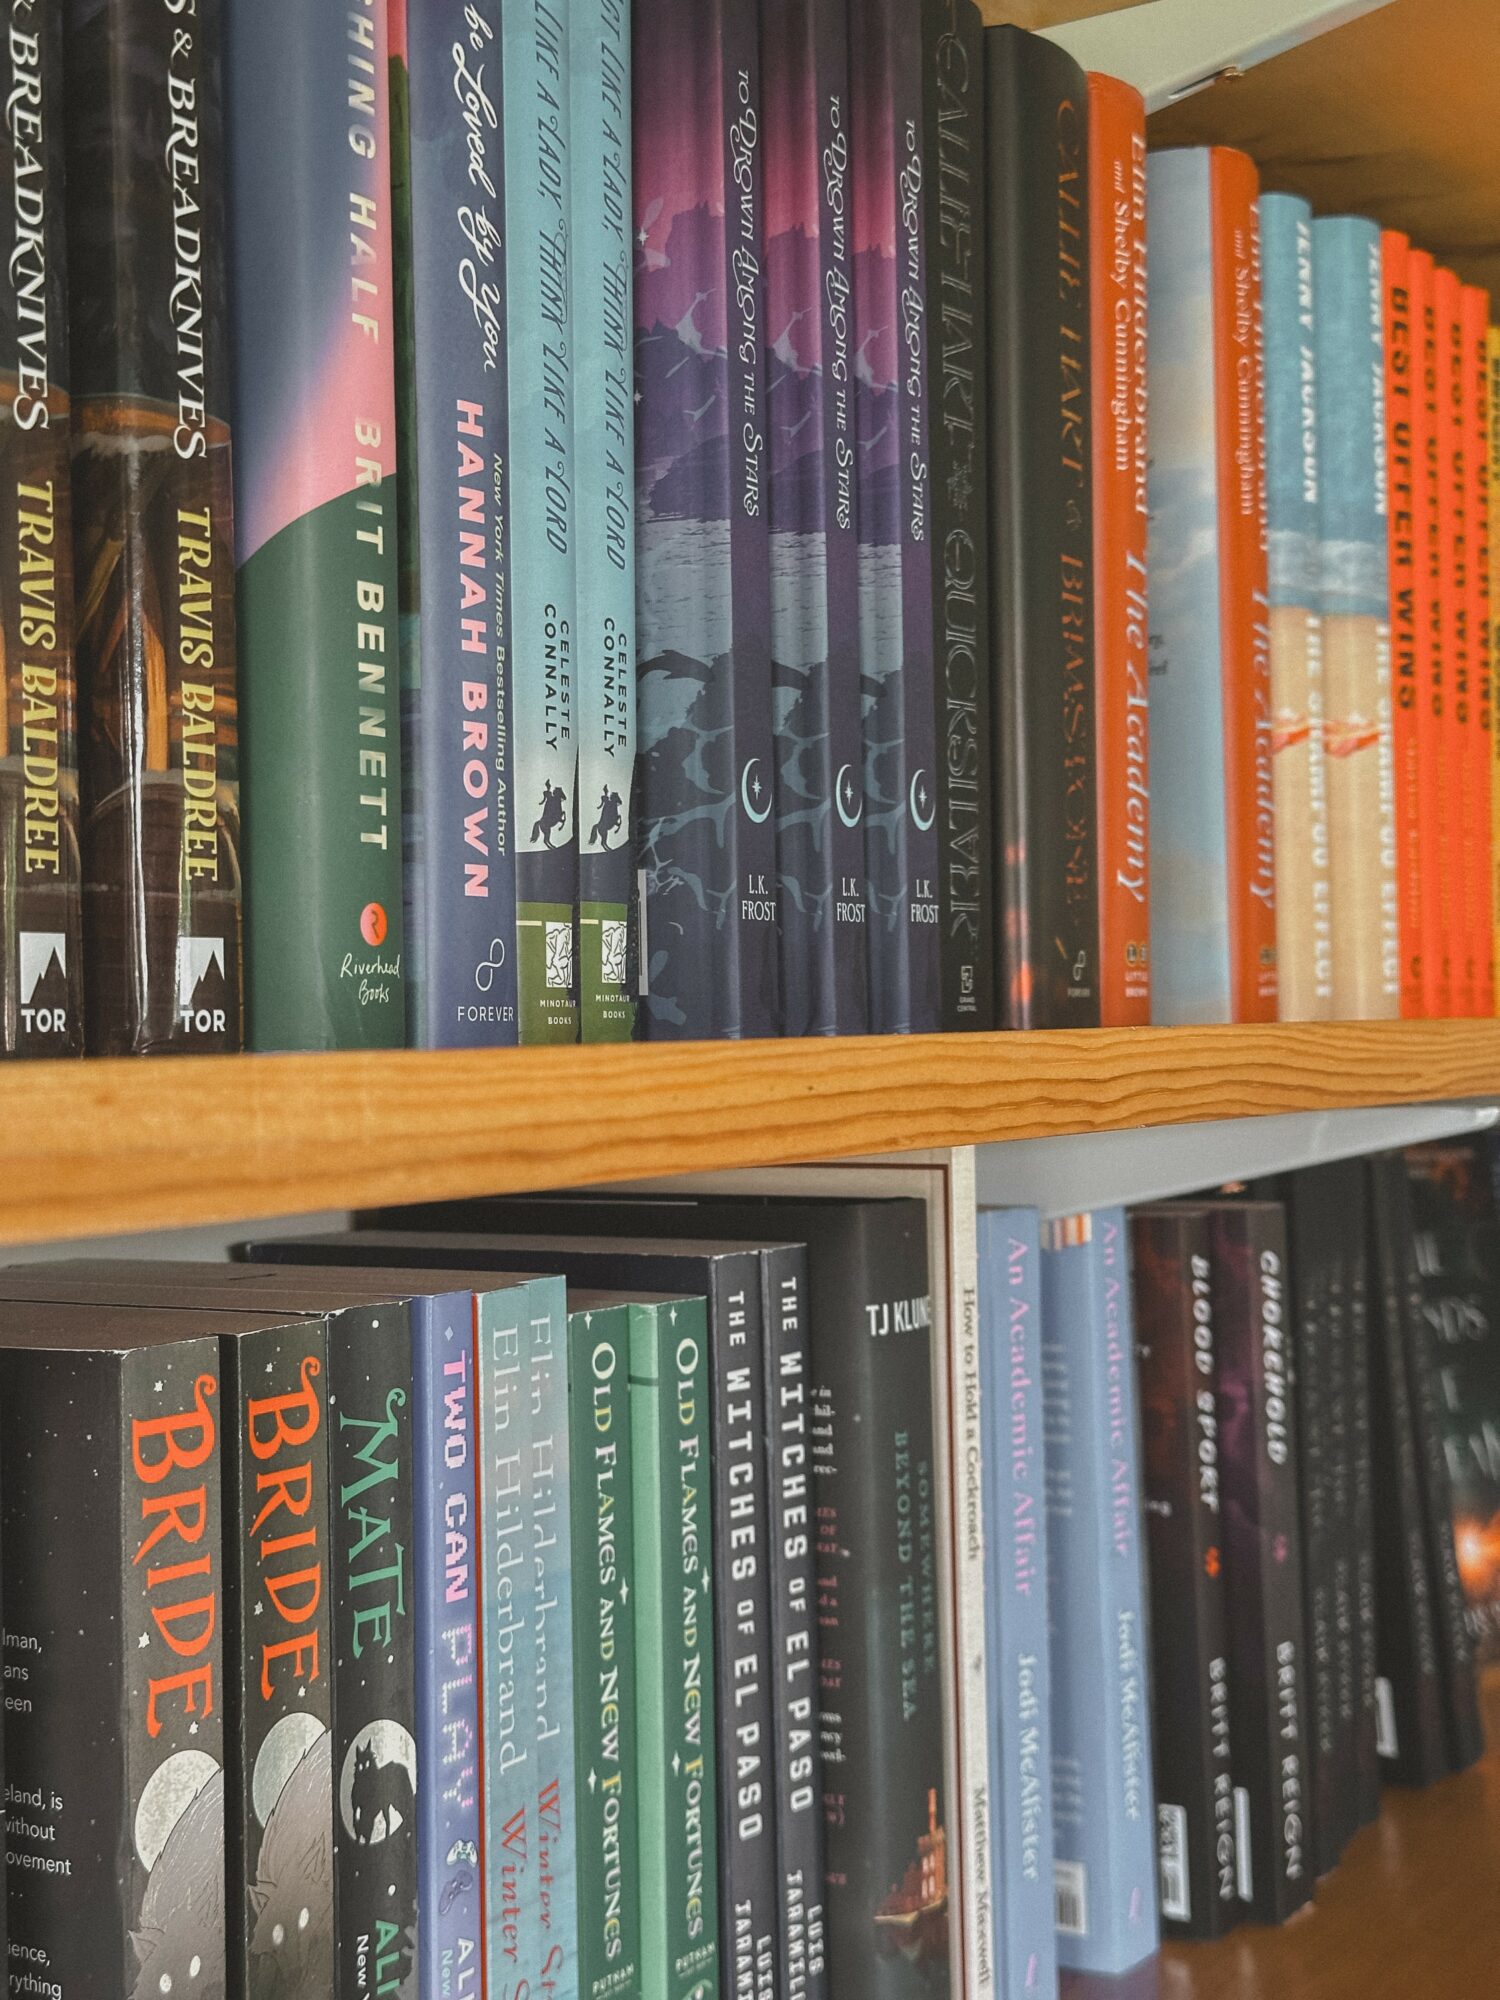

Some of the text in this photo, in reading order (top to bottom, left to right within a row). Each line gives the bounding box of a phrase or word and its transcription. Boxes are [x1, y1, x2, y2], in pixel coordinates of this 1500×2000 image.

[171, 28, 193, 60] &
[452, 42, 498, 199] Loved
[7, 25, 49, 429] BREADKNIVES
[165, 71, 207, 459] BREADKNIVES
[534, 0, 570, 555] LIKE A LADY, THINK LIKE A LORD
[458, 257, 501, 373] You
[1110, 159, 1132, 471] and Shelby Cunningham
[1133, 240, 1150, 516] Hilderbrand
[347, 0, 387, 850] HING HALF BRIT BENNETT
[17, 481, 57, 649] TRAVIS
[178, 508, 215, 667] TRAVIS
[456, 399, 489, 897] HANNAH BROWN
[494, 453, 508, 856] New York Times Bestselling Author
[545, 604, 558, 751] CONNALLY
[560, 620, 570, 740] CELESTE
[604, 617, 615, 758] CONNALLY
[618, 633, 628, 747] CELESTE
[21, 664, 60, 874] BALDREE
[181, 682, 218, 882] BALDREE
[943, 529, 979, 937] QUICKSILVER
[1117, 550, 1149, 902] The Academy
[742, 900, 776, 921] FROST
[747, 874, 768, 895] L.K.
[836, 902, 866, 922] FROST
[842, 877, 859, 897] L.K.
[910, 904, 939, 923] FROST
[916, 879, 933, 898] L.K.
[21, 1008, 66, 1032] TOR
[180, 1009, 226, 1033] TOR
[340, 952, 400, 1005] Riverhead Books
[457, 1006, 514, 1022] FOREVER
[540, 999, 576, 1008] MINOTAUR
[547, 1016, 572, 1025] BOOKS
[595, 994, 630, 1002] MINOTAUR
[602, 1010, 626, 1019] BOOKS
[493, 1324, 520, 1432] Elin
[530, 1313, 553, 1415] Elin
[591, 1342, 616, 1432] OLD
[676, 1338, 698, 1426] OLD
[865, 1295, 931, 1337] TJ KLUN
[1191, 1254, 1220, 1515] BLOOD SPORT
[1260, 1249, 1288, 1465] CHOKEHOLD
[963, 1288, 979, 1561] How to Hold a Cockroach
[1007, 1237, 1037, 1596] An Academic Affair
[131, 1373, 218, 1739] BRIDE
[247, 1356, 321, 1700] BRIDE
[339, 1388, 407, 1659] MATE
[595, 1441, 617, 1585] FLAMES
[679, 1435, 698, 1575] FLAMES
[726, 1291, 762, 1841] THE WITCHES OF EL PASO
[779, 1276, 813, 1813] THE WITCHES OF EL PASO
[894, 1431, 917, 1720] BEYOND THE SEA
[918, 1460, 934, 1674] SOMEWHERE
[441, 1350, 473, 1808] TWO CAN PLAY
[495, 1448, 527, 1775] Hilderbrand
[531, 1435, 560, 1741] Hilderbrand
[600, 1601, 614, 1660] AND
[683, 1586, 697, 1647] AND
[600, 1665, 618, 1762] NEW
[683, 1653, 701, 1745] NEW
[1018, 1653, 1039, 1720] Jodi
[51, 1792, 64, 1810] is
[538, 1778, 561, 1929] Winter
[602, 1770, 622, 1961] FORTUNES
[685, 1754, 703, 1940] FORTUNES
[502, 1802, 527, 1964] Winter
[807, 1904, 825, 1976] LUIS
[973, 1787, 990, 1985] Matthew Maxwell
[357, 1935, 369, 1986] New
[376, 1920, 400, 1995] ALI
[441, 1948, 453, 1997] New
